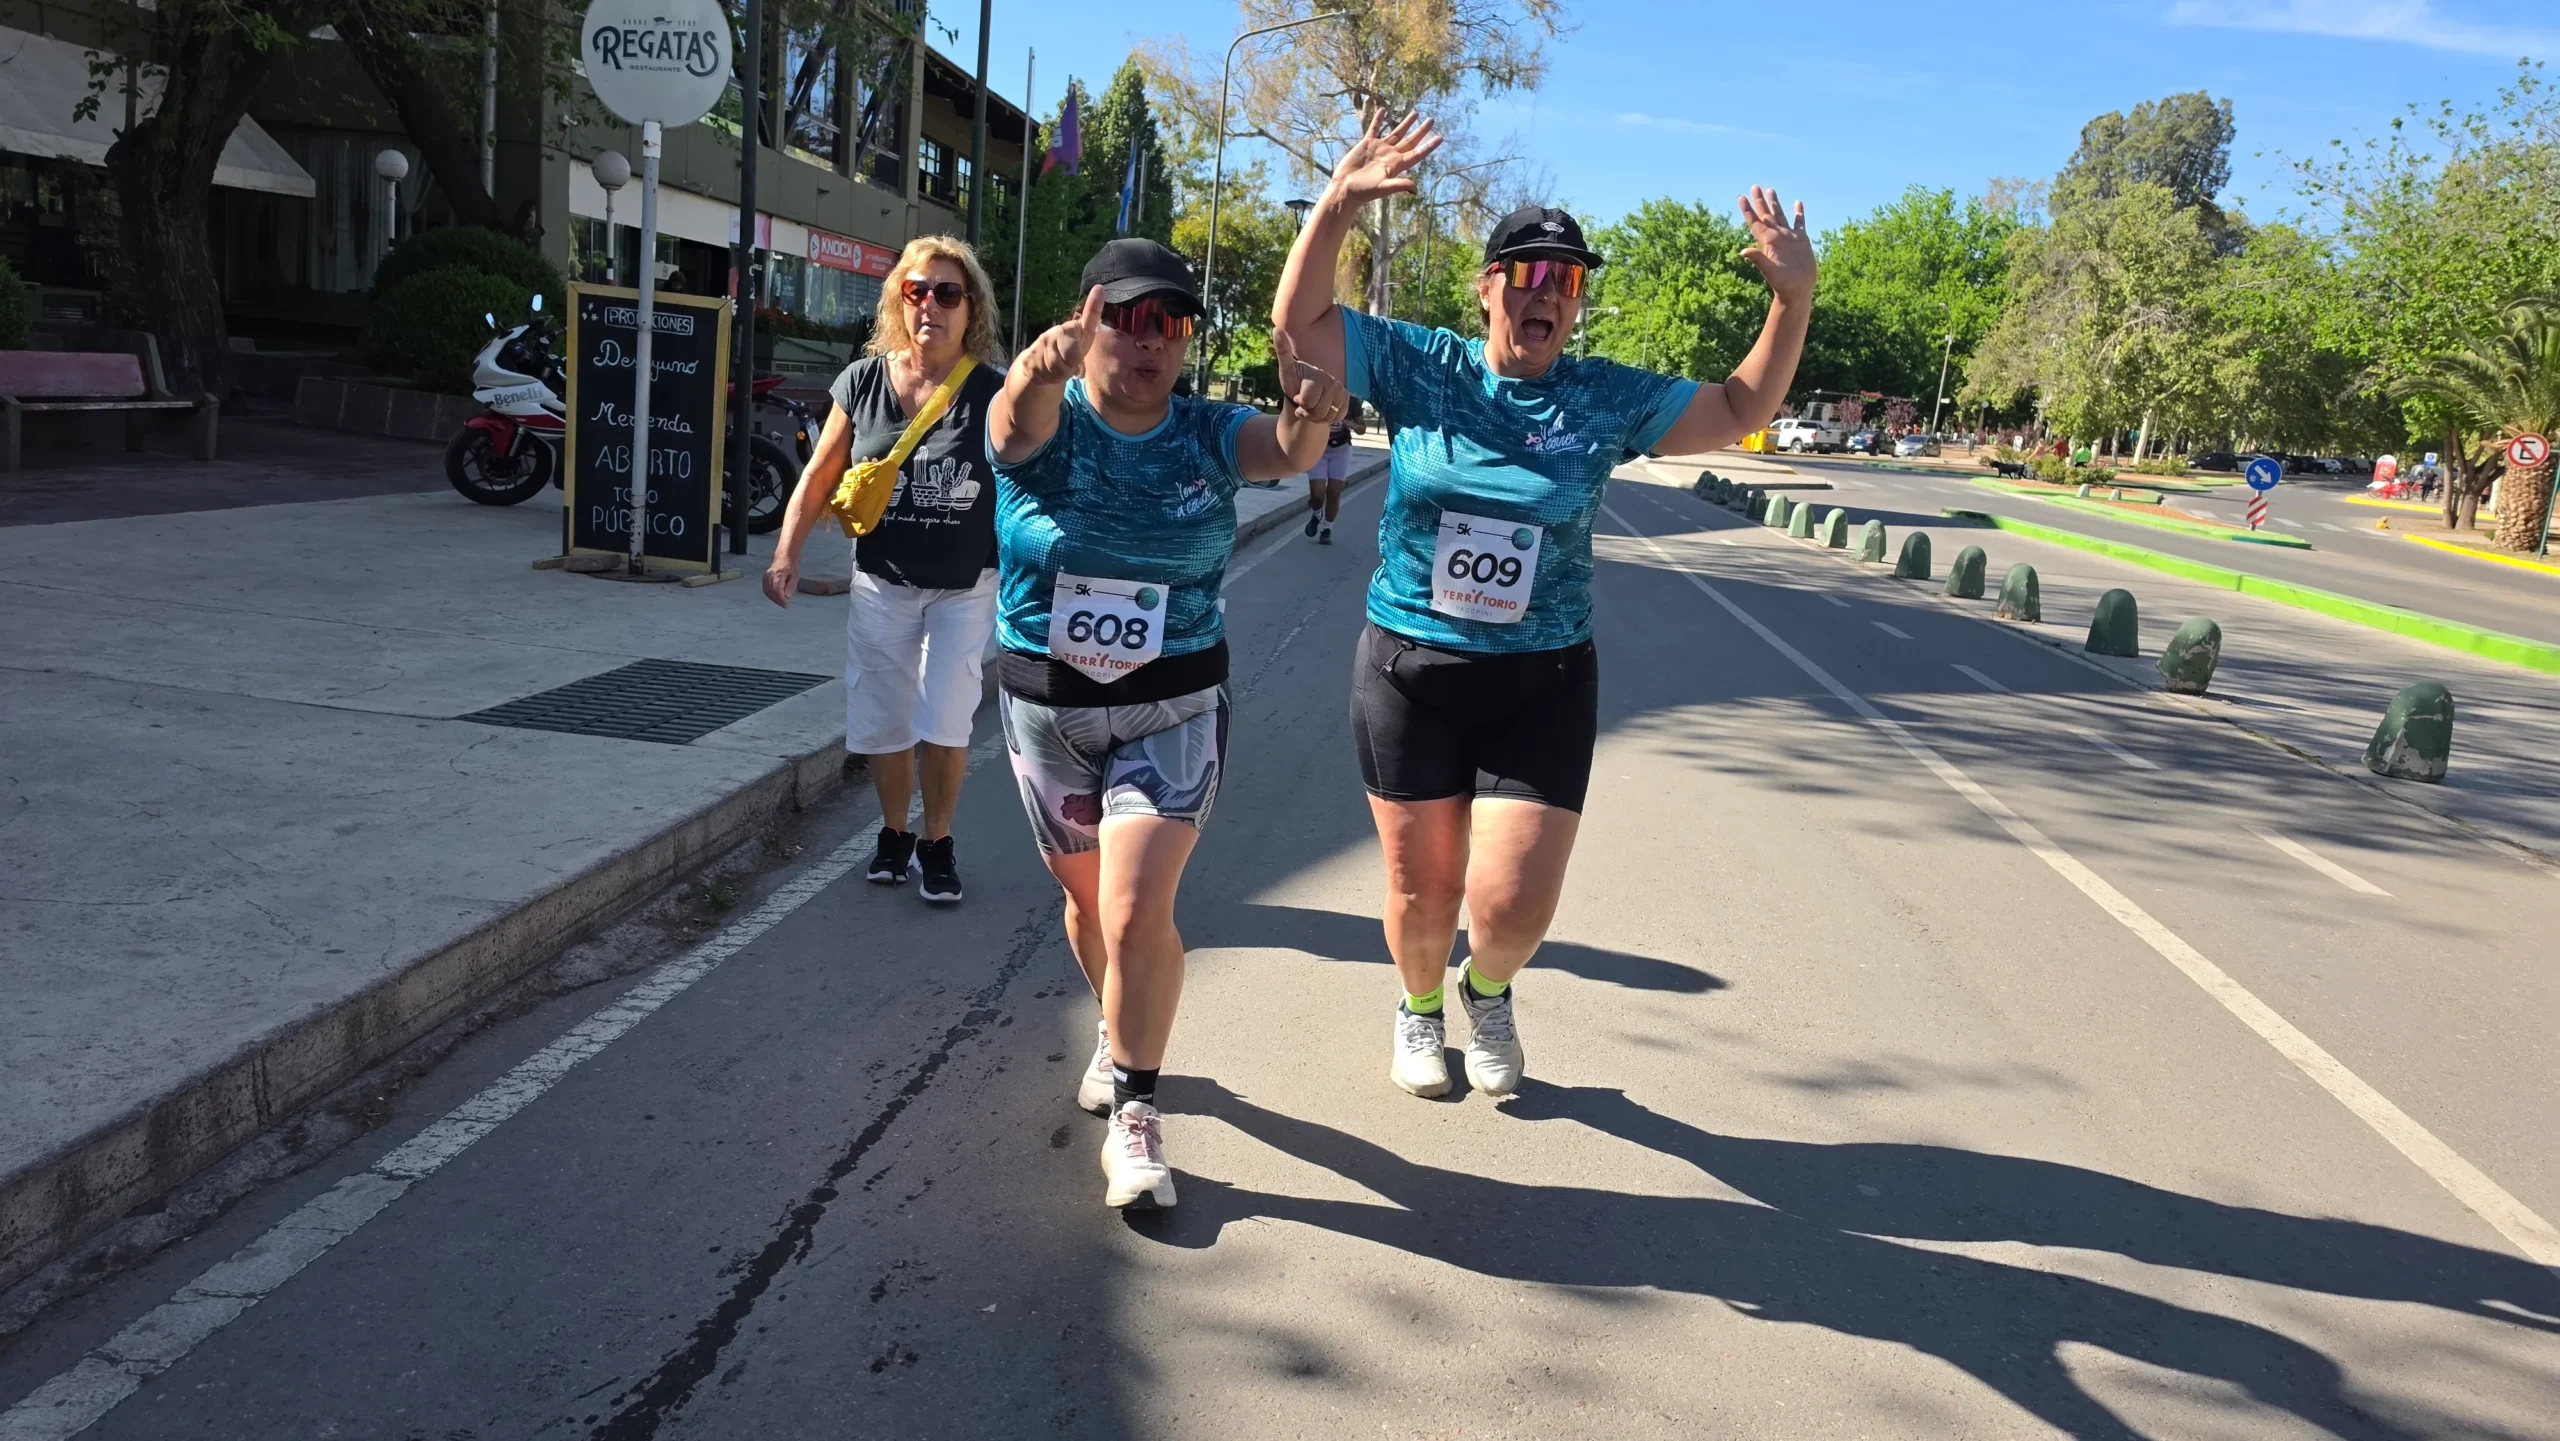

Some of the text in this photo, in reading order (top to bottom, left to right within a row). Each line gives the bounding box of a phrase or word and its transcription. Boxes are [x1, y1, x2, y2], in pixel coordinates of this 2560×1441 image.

[592, 26, 718, 77] REGATAS
[609, 309, 690, 333] PROCIONES
[493, 387, 544, 406] Benelli
[591, 402, 694, 434] Merenda
[595, 444, 691, 479] ABRTO
[613, 486, 658, 504] TOO
[1456, 523, 1472, 536] 5k
[1447, 549, 1522, 588] 609
[1074, 584, 1092, 597] 5k
[1067, 610, 1149, 650] 608
